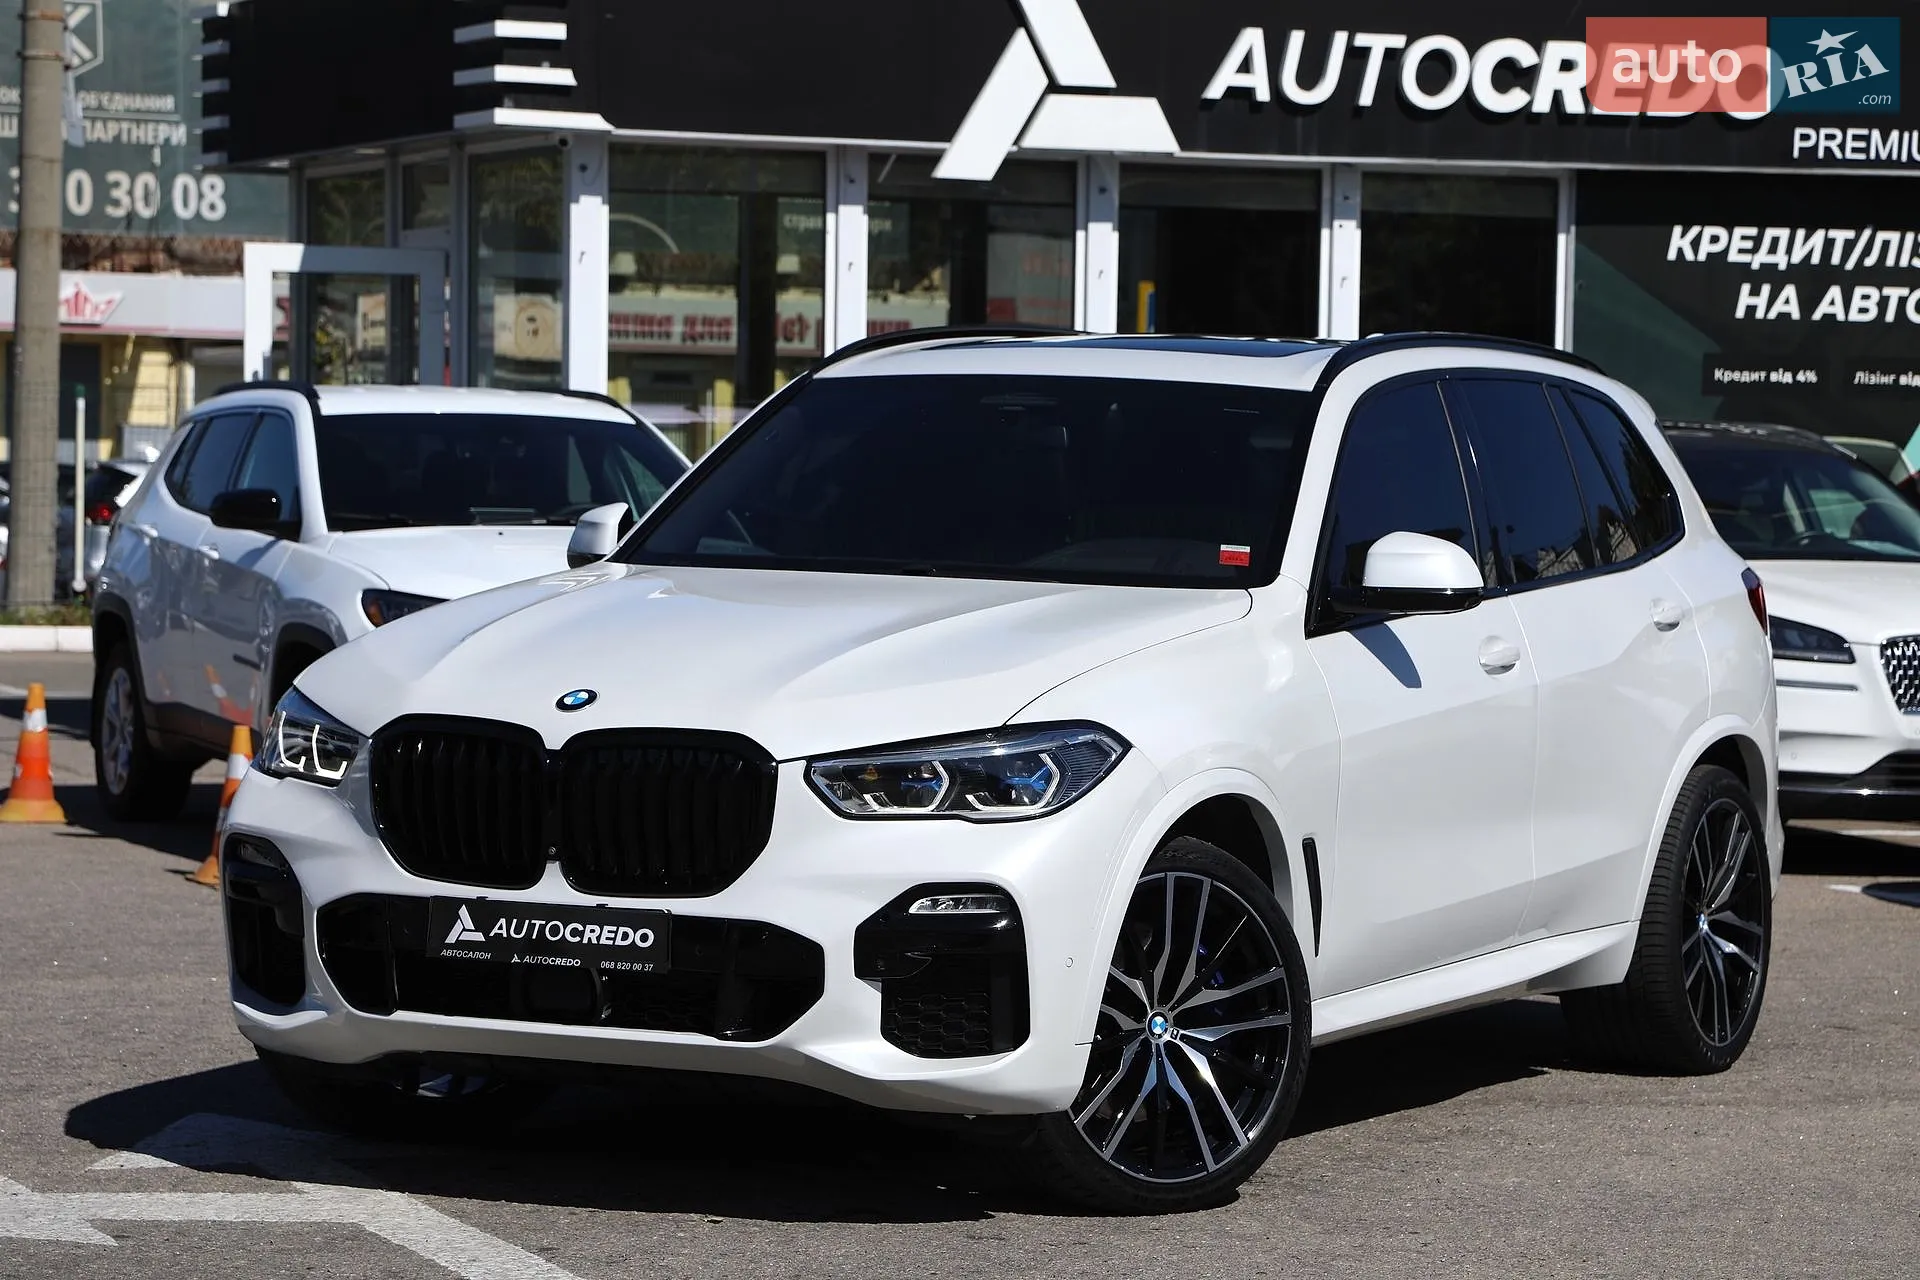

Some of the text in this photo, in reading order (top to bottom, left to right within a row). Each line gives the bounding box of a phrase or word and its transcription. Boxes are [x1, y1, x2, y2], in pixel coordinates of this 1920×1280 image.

[1202, 26, 1784, 121] AUTOCREDO
[104, 170, 160, 219] 30
[172, 173, 227, 222] 08
[1735, 282, 1801, 321] НА
[1714, 368, 1766, 384] Кредит
[489, 917, 655, 949] AUTOCREDO
[440, 949, 492, 960] АВТОСАЛОН
[522, 954, 581, 967] AUTOCREDO
[600, 960, 615, 969] 068
[643, 963, 654, 972] 37
